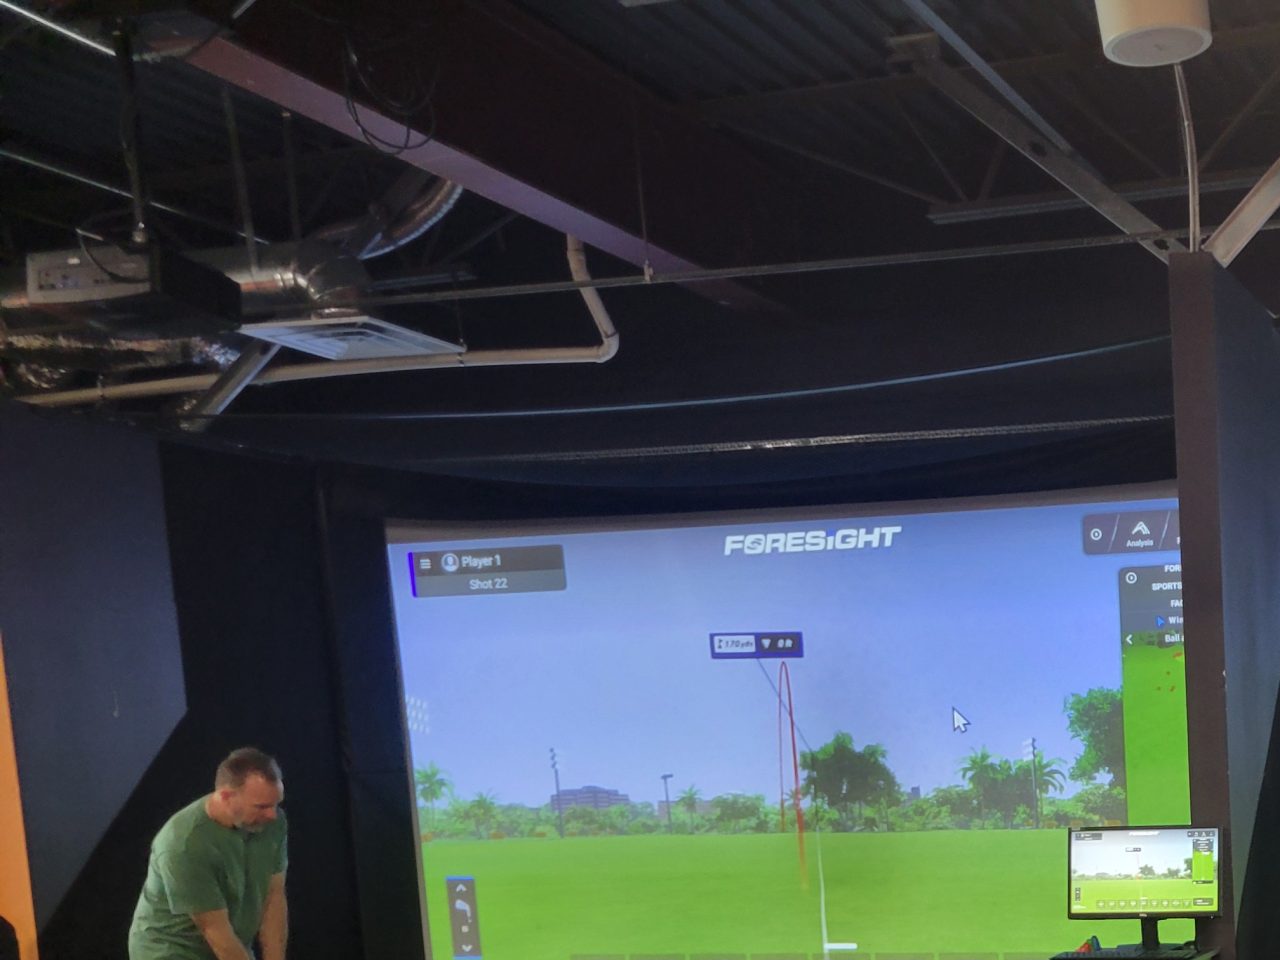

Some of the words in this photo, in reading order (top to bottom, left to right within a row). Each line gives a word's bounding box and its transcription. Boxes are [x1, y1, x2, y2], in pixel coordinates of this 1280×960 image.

[461, 556, 493, 569] Player
[495, 554, 501, 565] 1
[469, 579, 493, 589] Shot
[494, 578, 508, 589] 22
